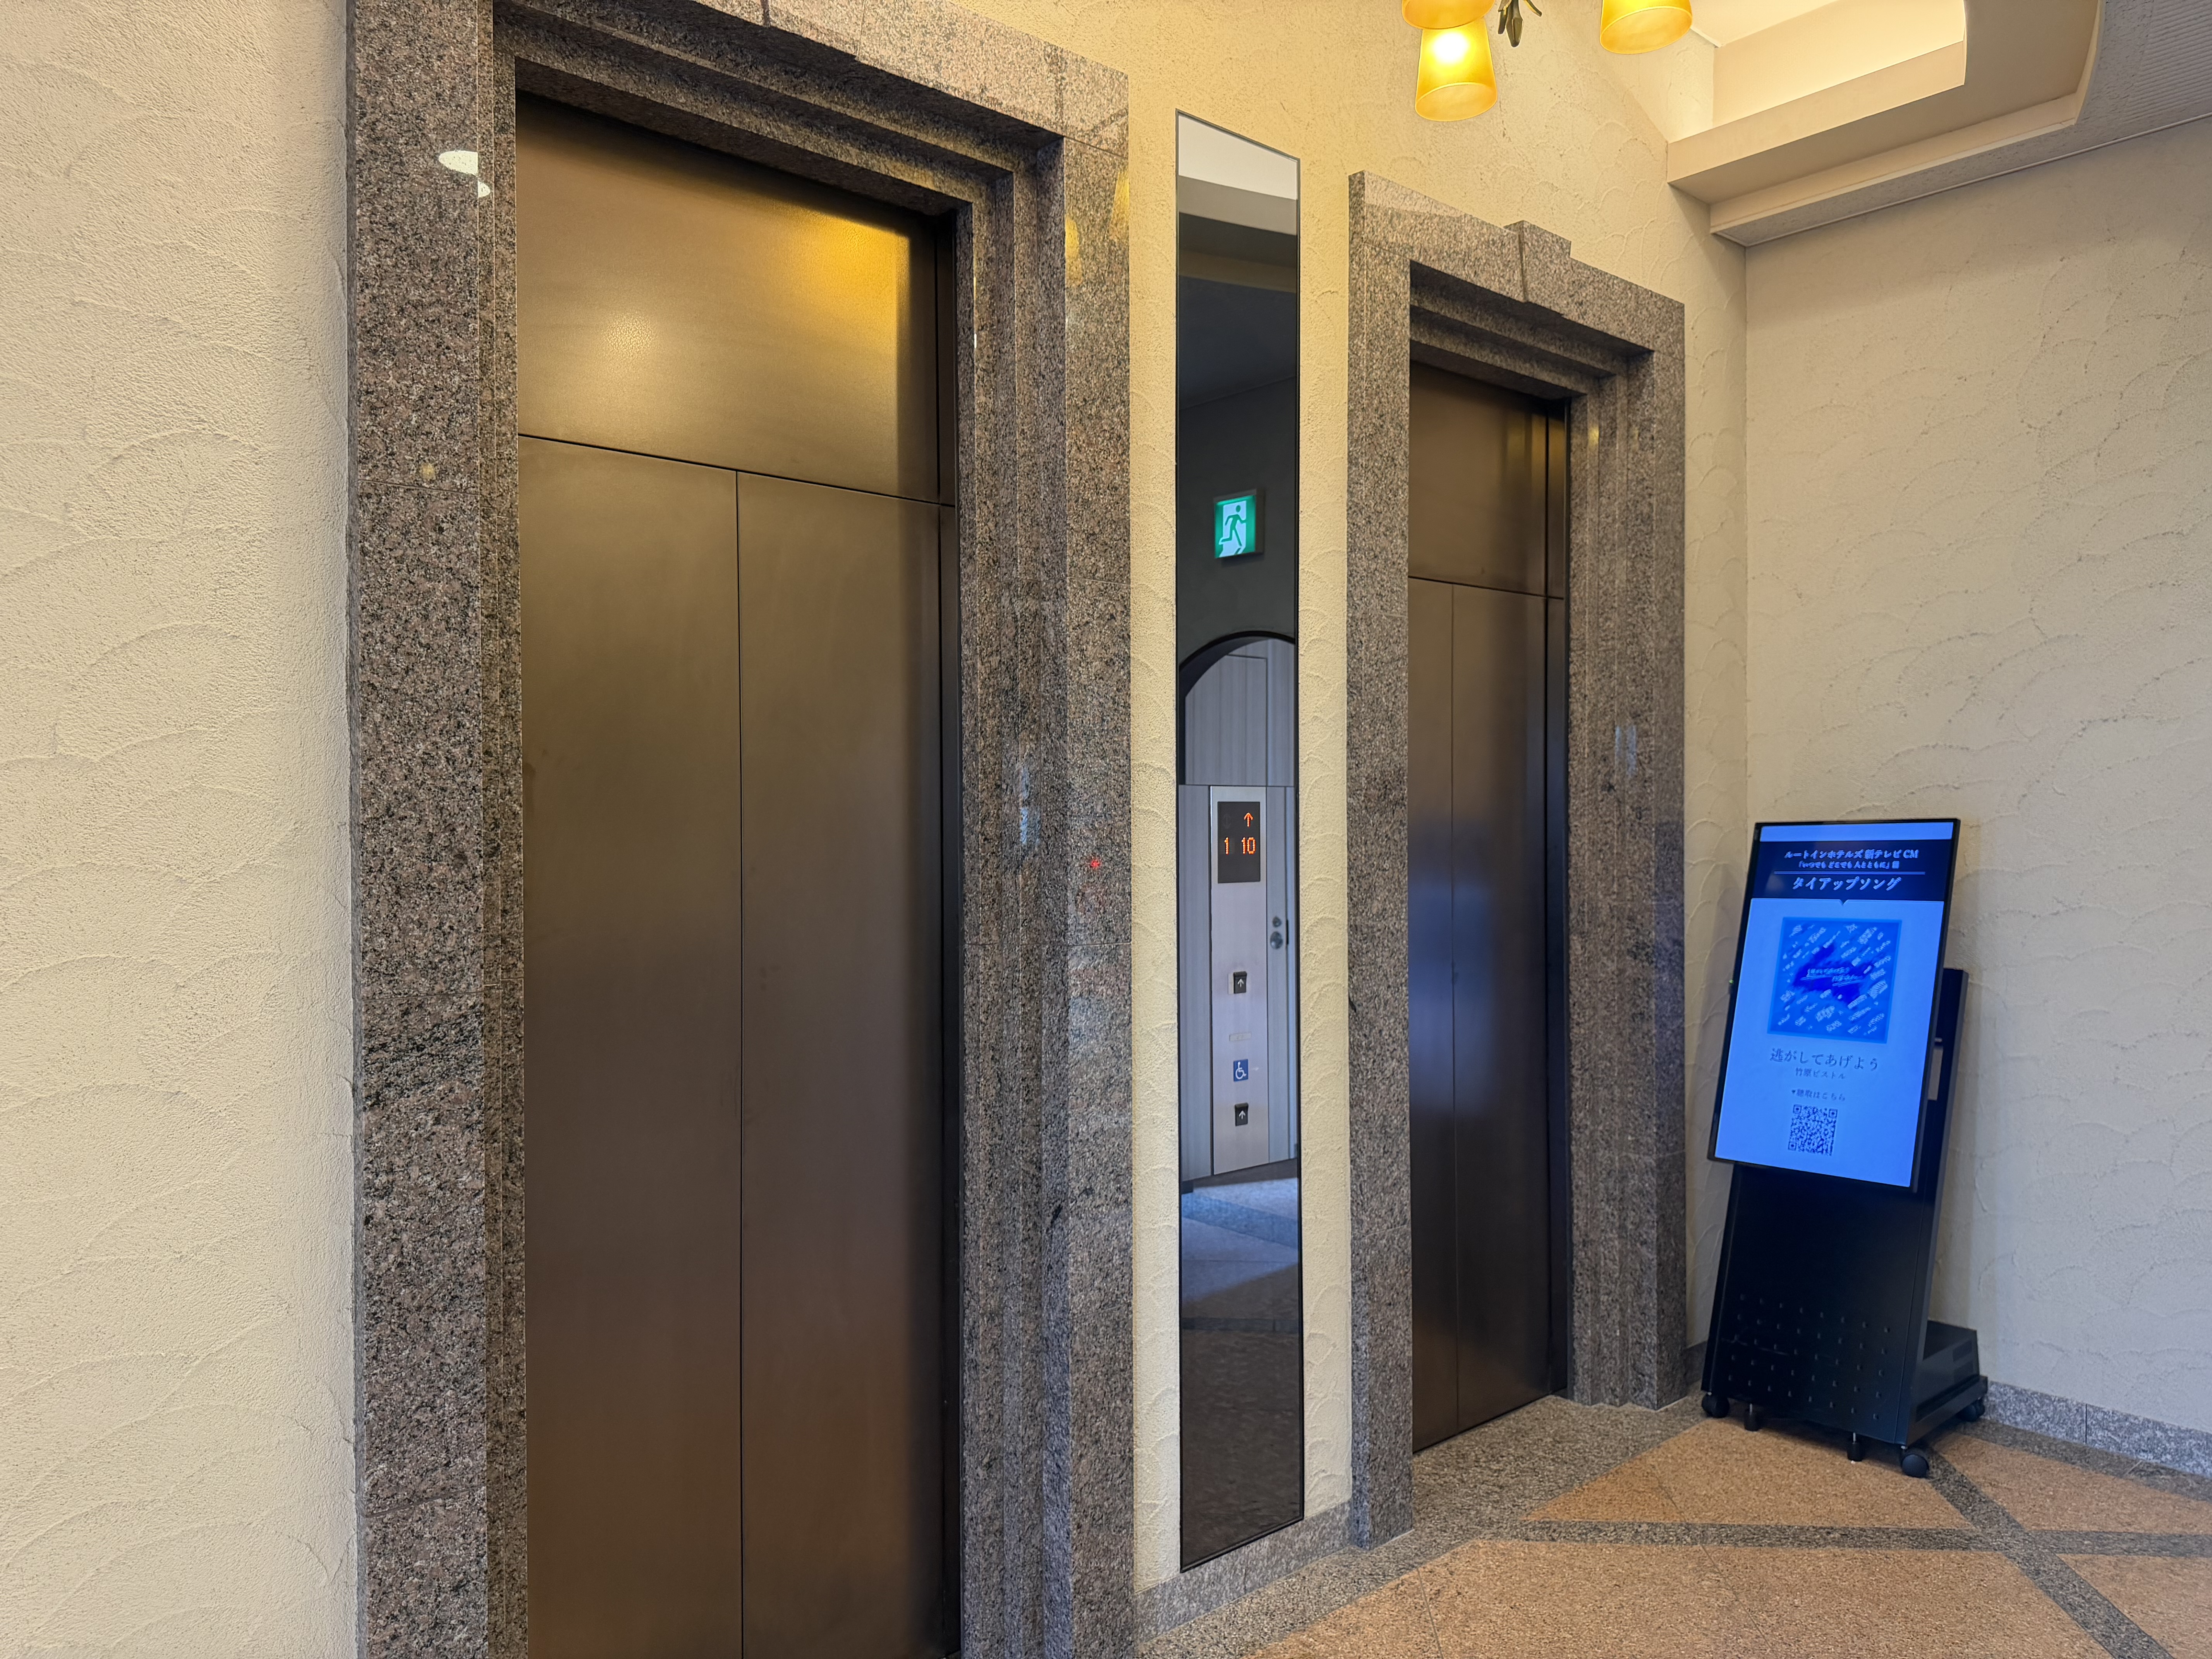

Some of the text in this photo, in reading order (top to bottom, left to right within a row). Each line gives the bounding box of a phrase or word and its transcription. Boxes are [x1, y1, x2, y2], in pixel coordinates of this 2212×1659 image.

[1224, 837, 1256, 854] 1 10
[1793, 876, 1902, 891] タイアップソング
[1770, 1048, 1878, 1071] 逃がしてあげよう
